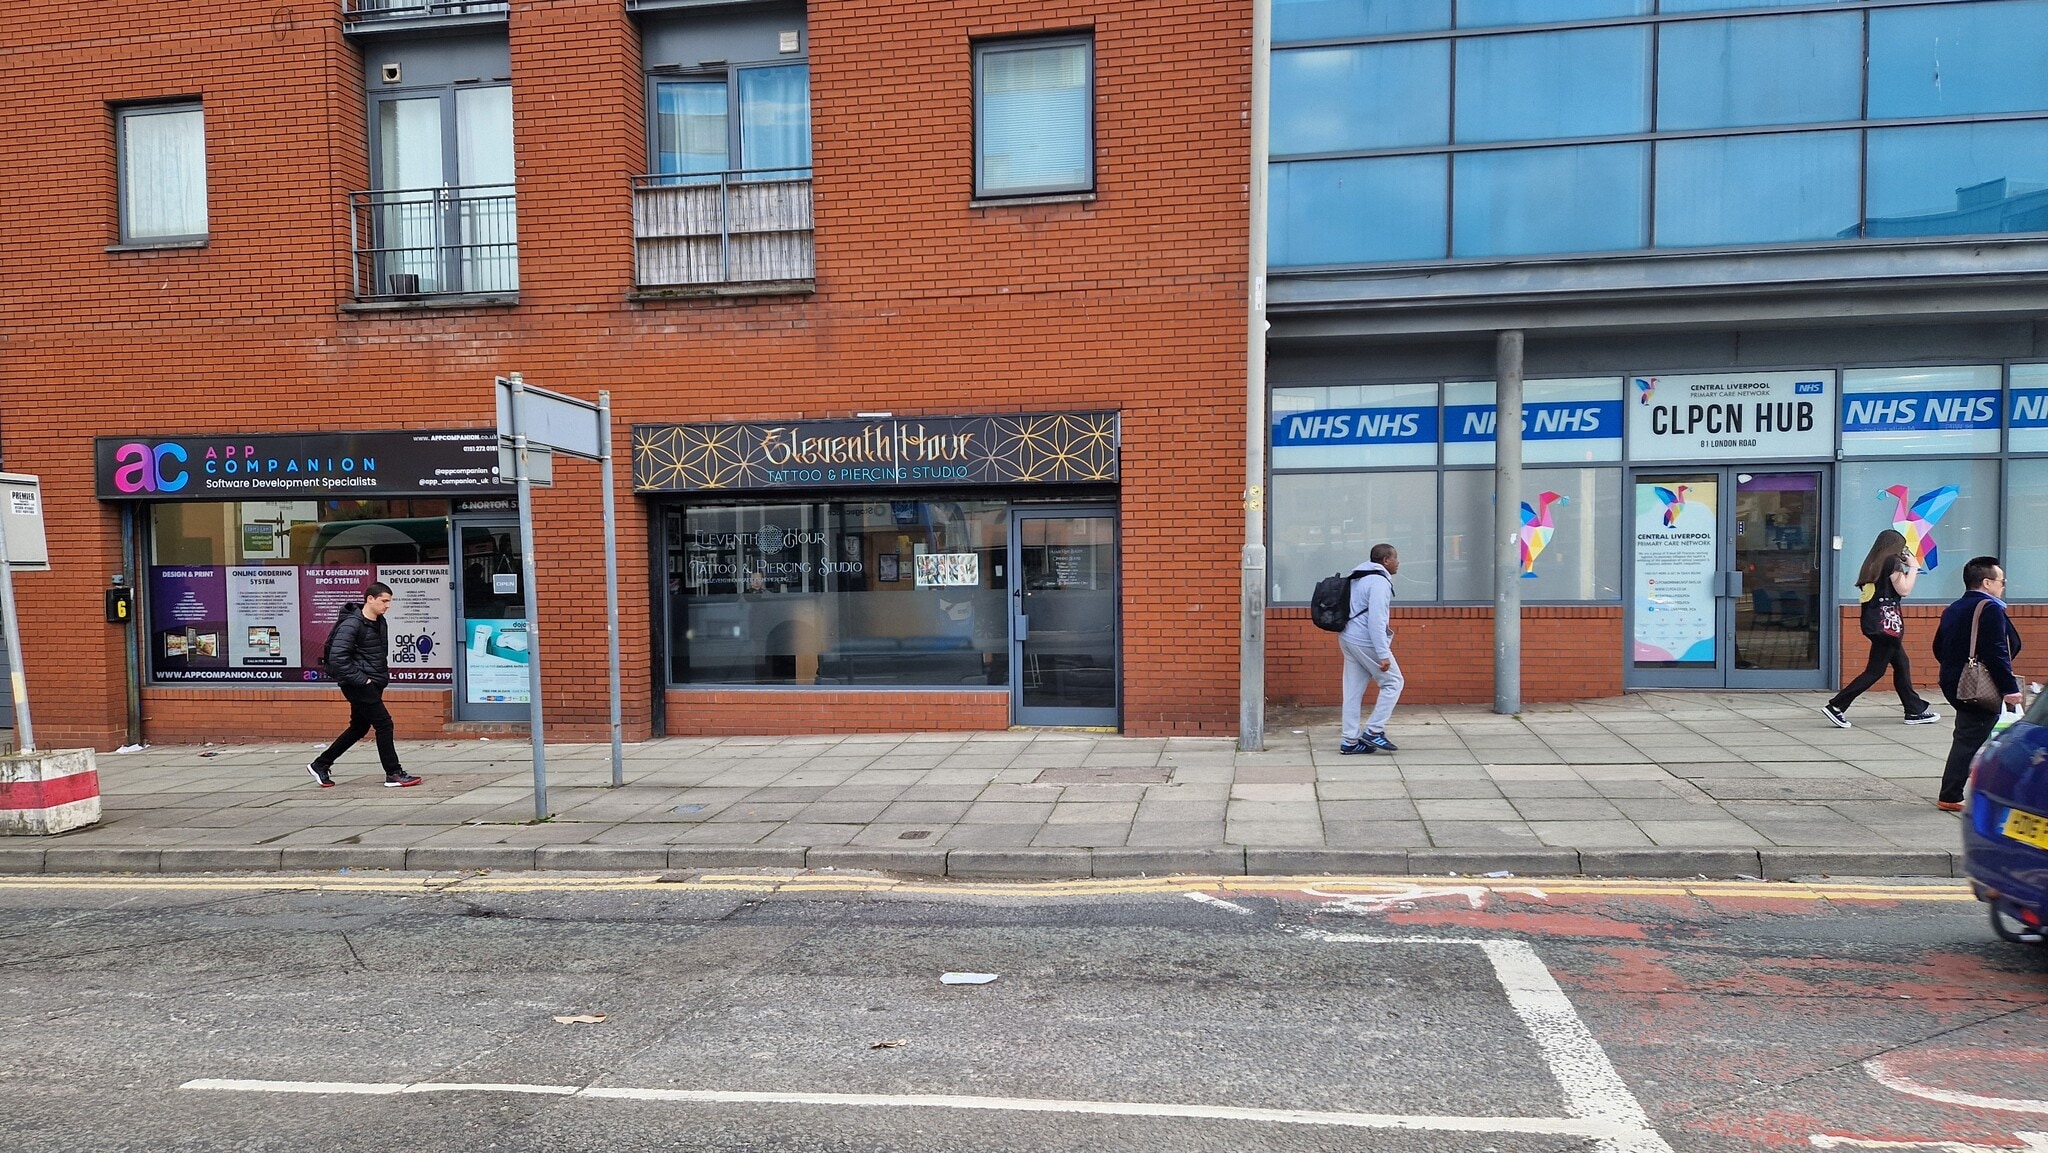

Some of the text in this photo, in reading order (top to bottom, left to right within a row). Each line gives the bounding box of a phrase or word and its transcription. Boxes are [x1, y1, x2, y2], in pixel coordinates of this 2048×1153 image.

[1799, 384, 1820, 392] NHS
[1846, 397, 1996, 425] NHS NHS
[1534, 408, 1601, 432] NHS
[1653, 401, 1813, 435] CLPCN HUB
[1288, 414, 1419, 439] NHS NHS
[761, 424, 974, 465] Eleventh Hour
[1700, 439, 1757, 448] 81 LONDON ROAD
[206, 446, 255, 458] APP
[115, 442, 189, 493] ac
[206, 458, 376, 473] COMPANION
[434, 467, 488, 476] @appcompanion
[767, 465, 968, 482] TATTOO & PIERCING STUDIO
[206, 476, 377, 490] Software Development Specialists
[419, 477, 489, 486] @app_companion_uk
[469, 500, 509, 510] NORTON
[412, 568, 449, 576] SOFTWARE
[742, 563, 752, 574] &
[1013, 589, 1020, 598] 4
[117, 600, 126, 617] 6
[395, 633, 415, 647] got
[402, 644, 415, 653] an
[392, 650, 416, 663] idea
[156, 671, 282, 679] WWW.APPCOMPANION.CO.UK
[398, 672, 416, 680] 0151
[418, 672, 435, 680] 272
